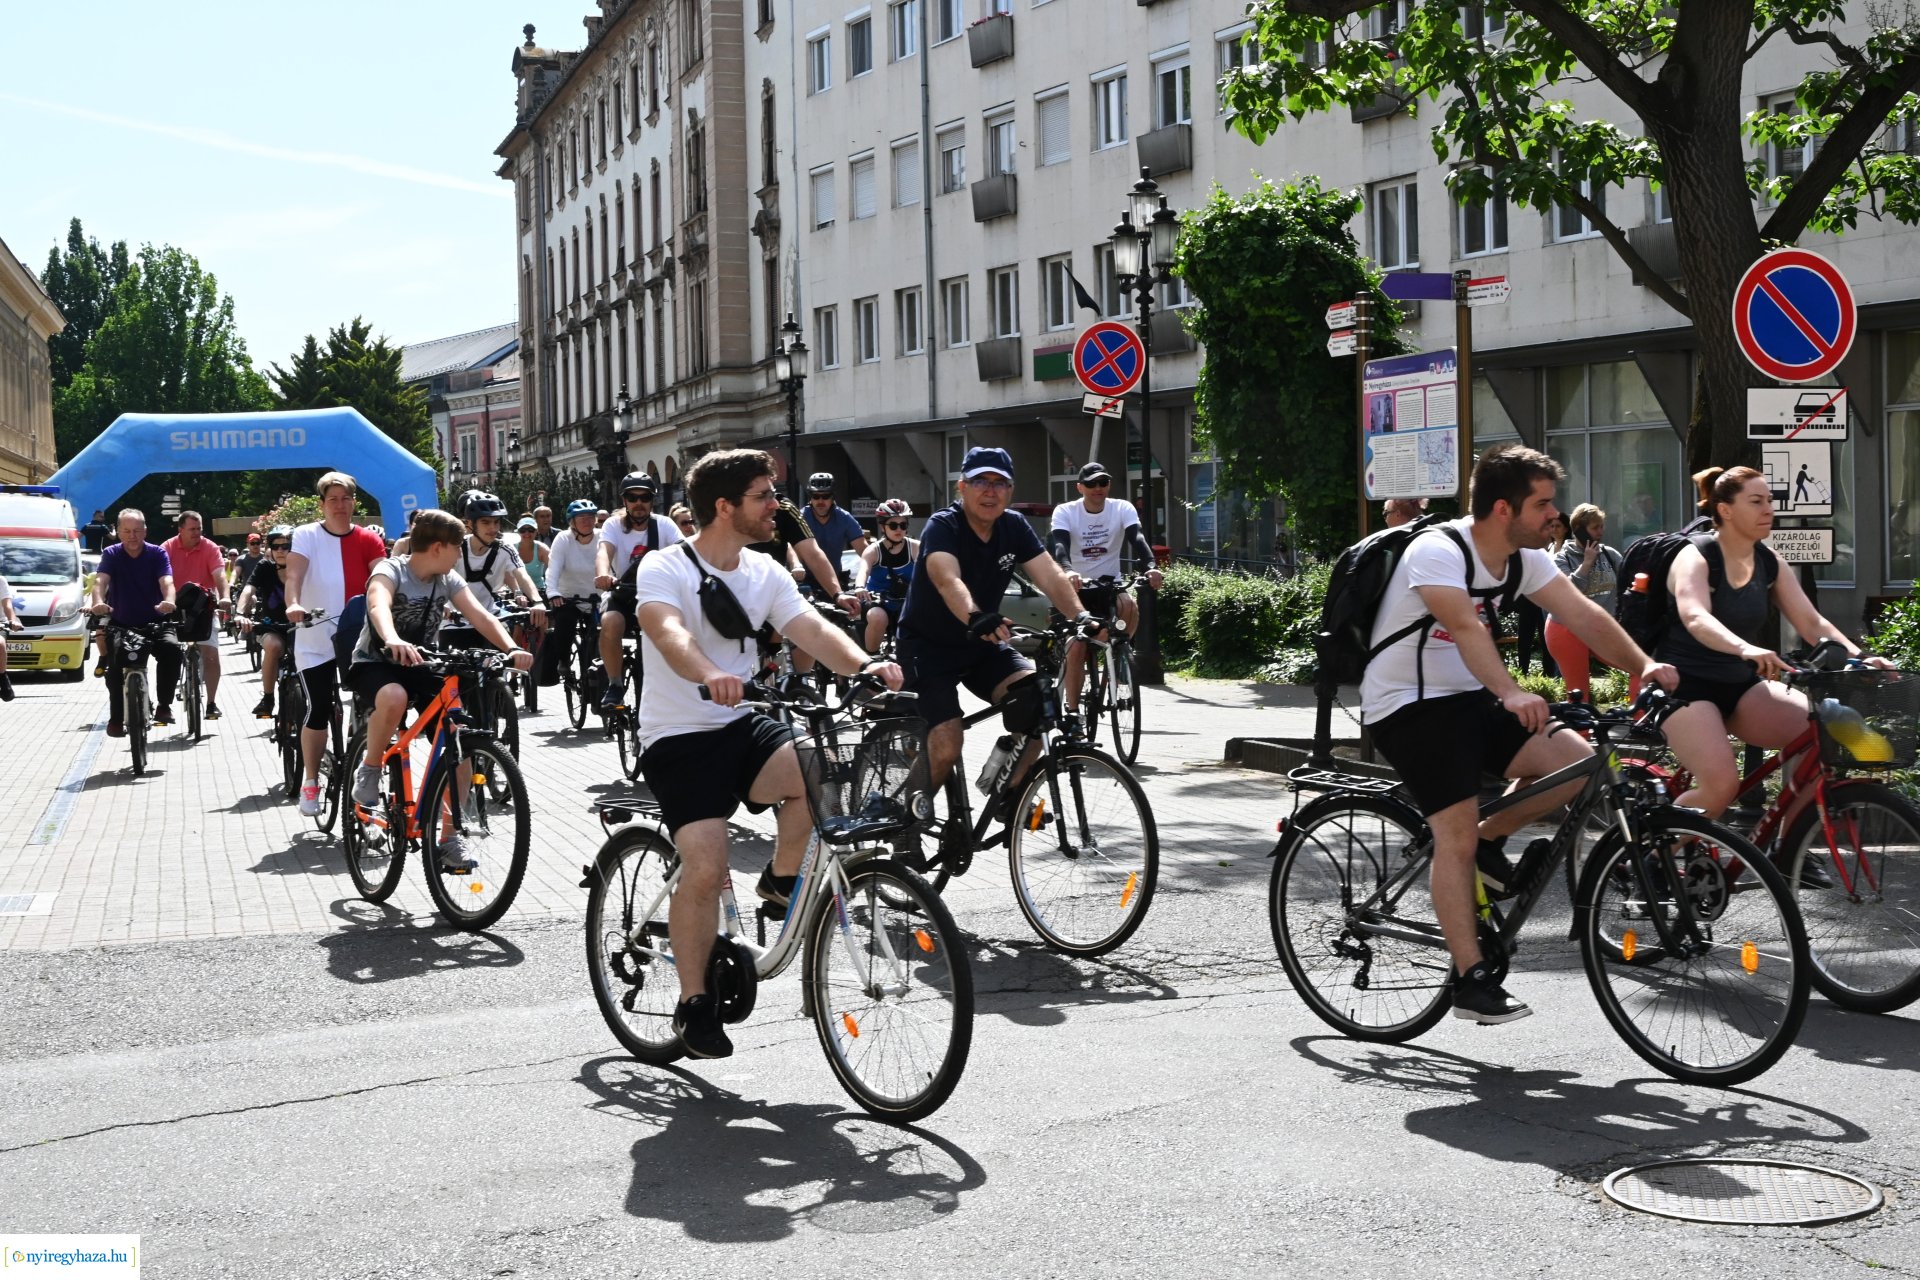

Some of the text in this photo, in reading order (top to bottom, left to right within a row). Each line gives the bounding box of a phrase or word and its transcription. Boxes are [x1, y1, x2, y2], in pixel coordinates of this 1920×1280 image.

[169, 428, 307, 450] SHIMANO
[1772, 531, 1821, 541] KIZÁRÓLAG
[1780, 551, 1827, 561] GEDÉLLYEL
[6, 643, 30, 651] N-624
[996, 735, 1028, 794] ALPINA
